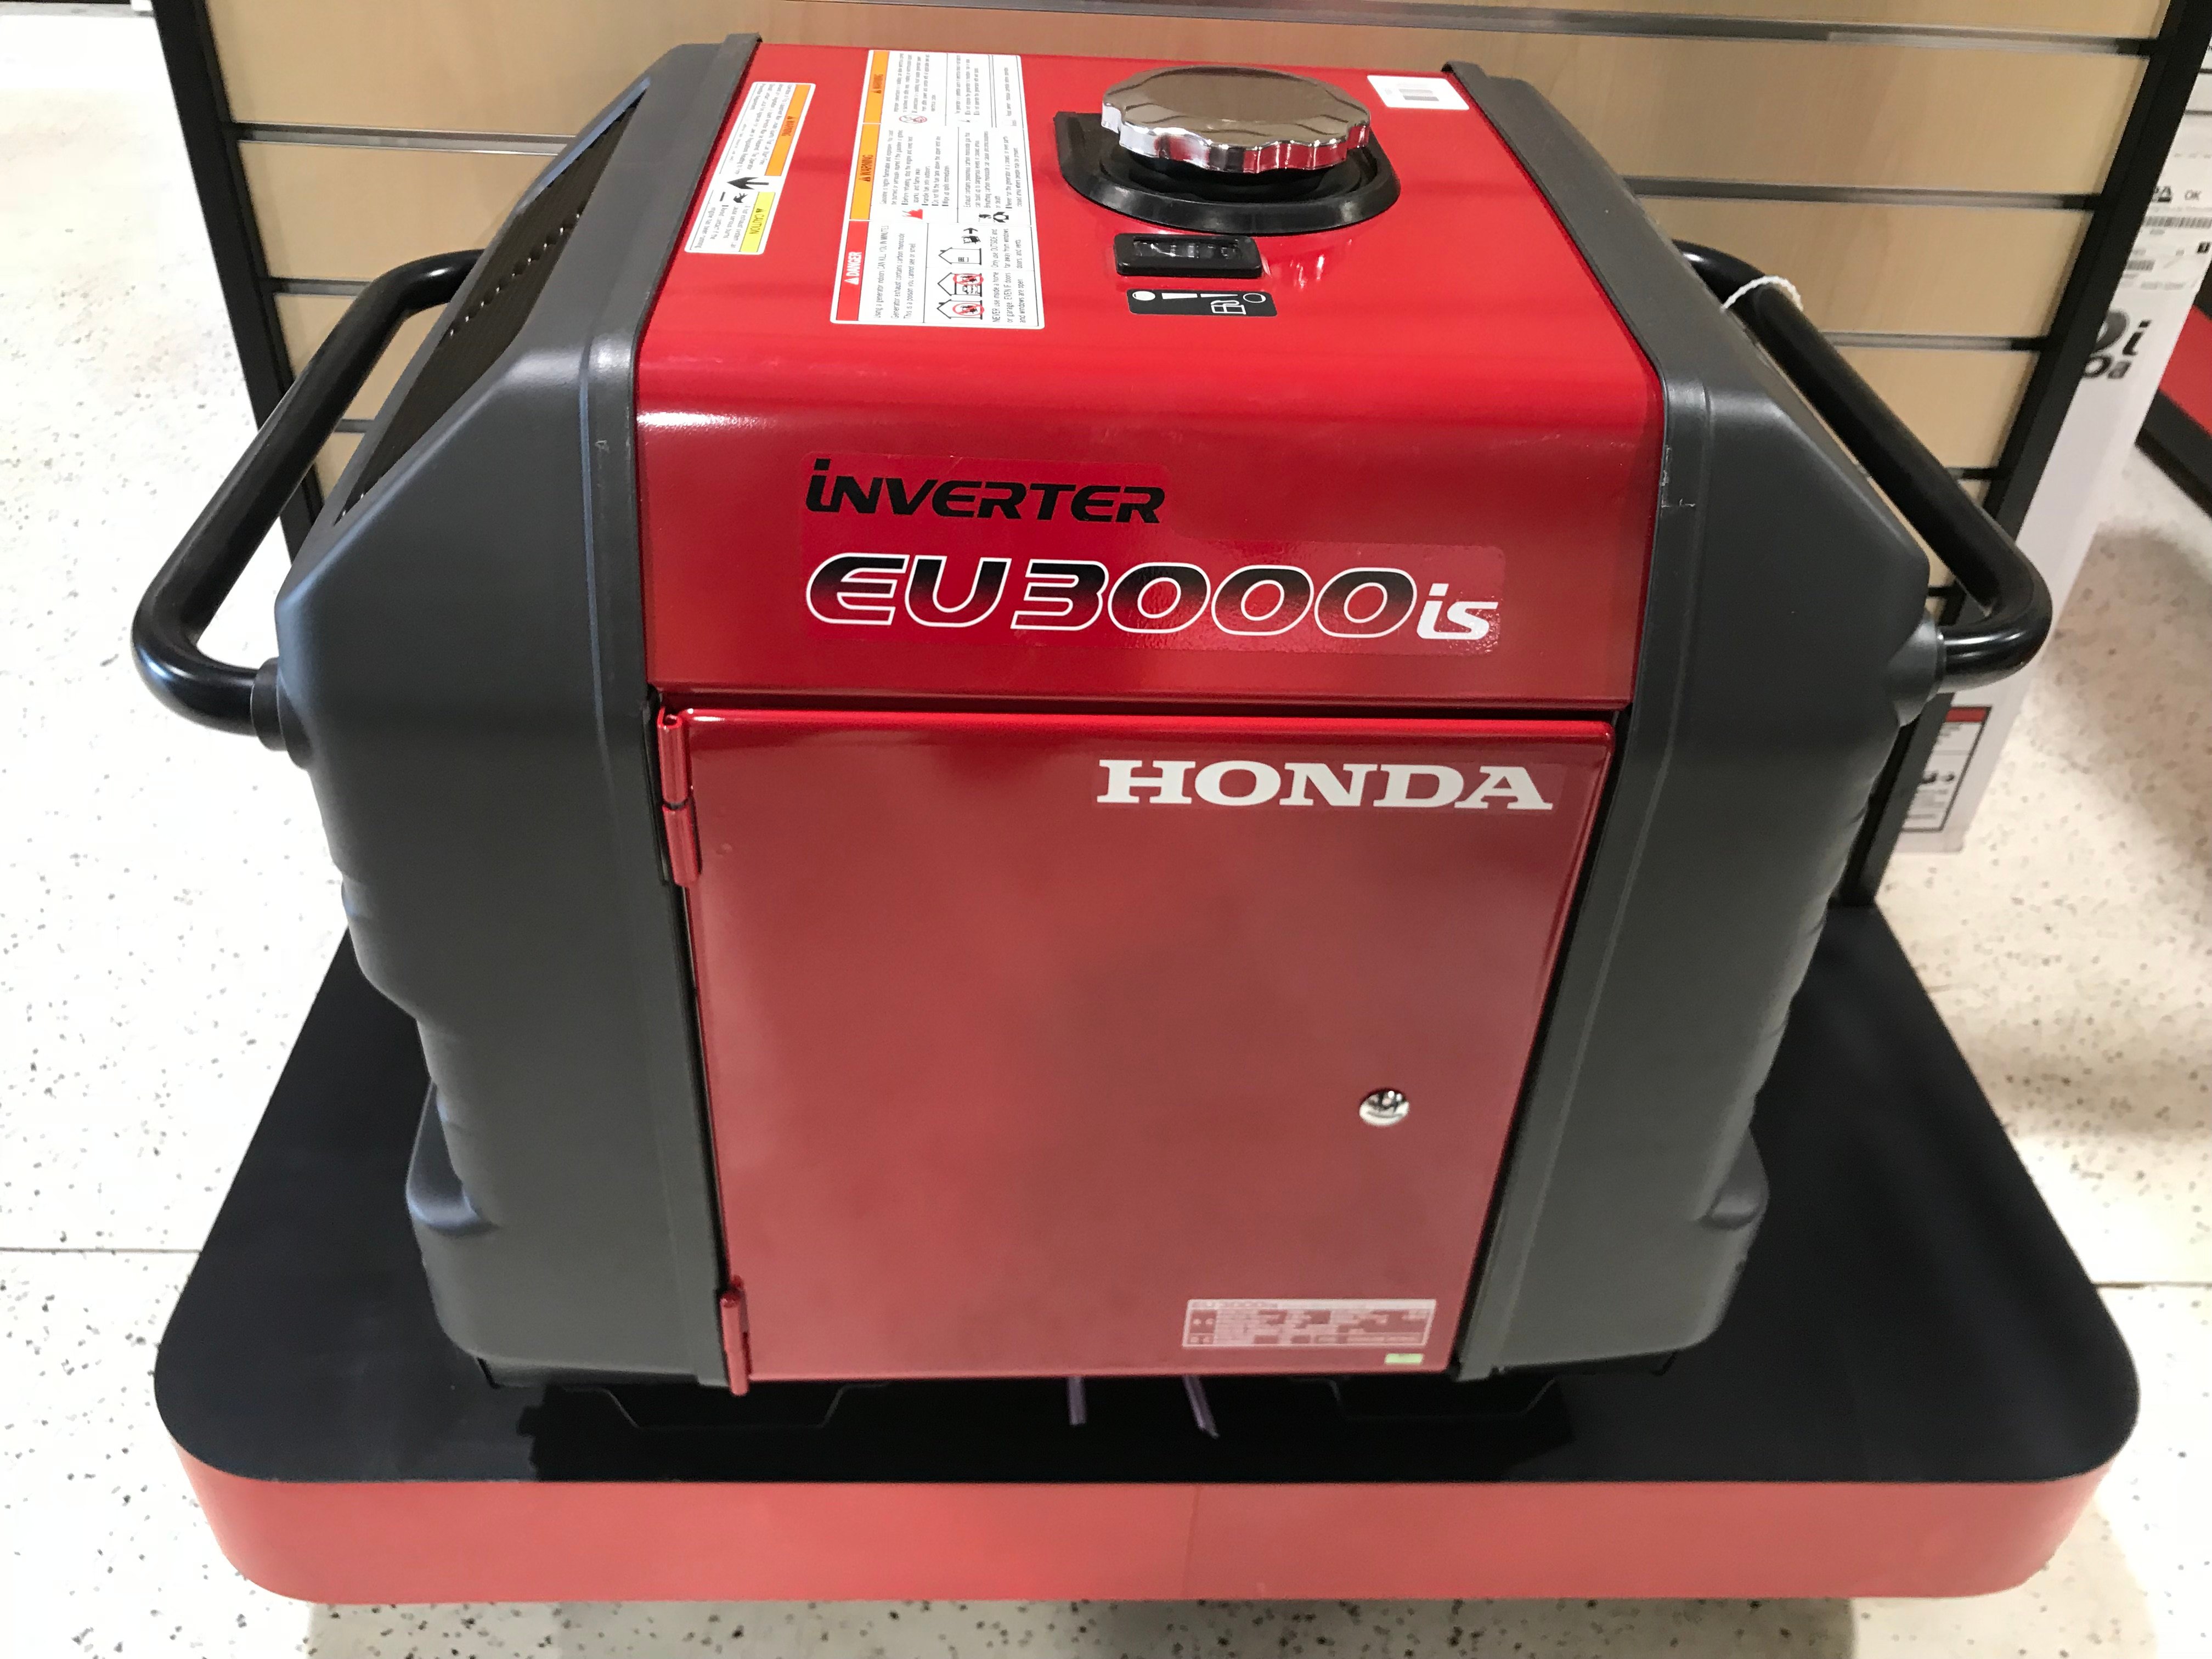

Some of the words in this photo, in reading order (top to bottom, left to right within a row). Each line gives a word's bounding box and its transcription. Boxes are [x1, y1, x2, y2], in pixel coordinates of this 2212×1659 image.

[860, 155, 873, 176] WARNING
[749, 215, 764, 234] CAUTION
[846, 252, 862, 276] DANGER
[1004, 289, 1012, 300] EVEN
[873, 308, 883, 318] Using
[891, 298, 900, 318] Generator
[992, 308, 1000, 322] NEVER
[806, 551, 1499, 641] EU3000is
[1097, 759, 1553, 810] HONDA
